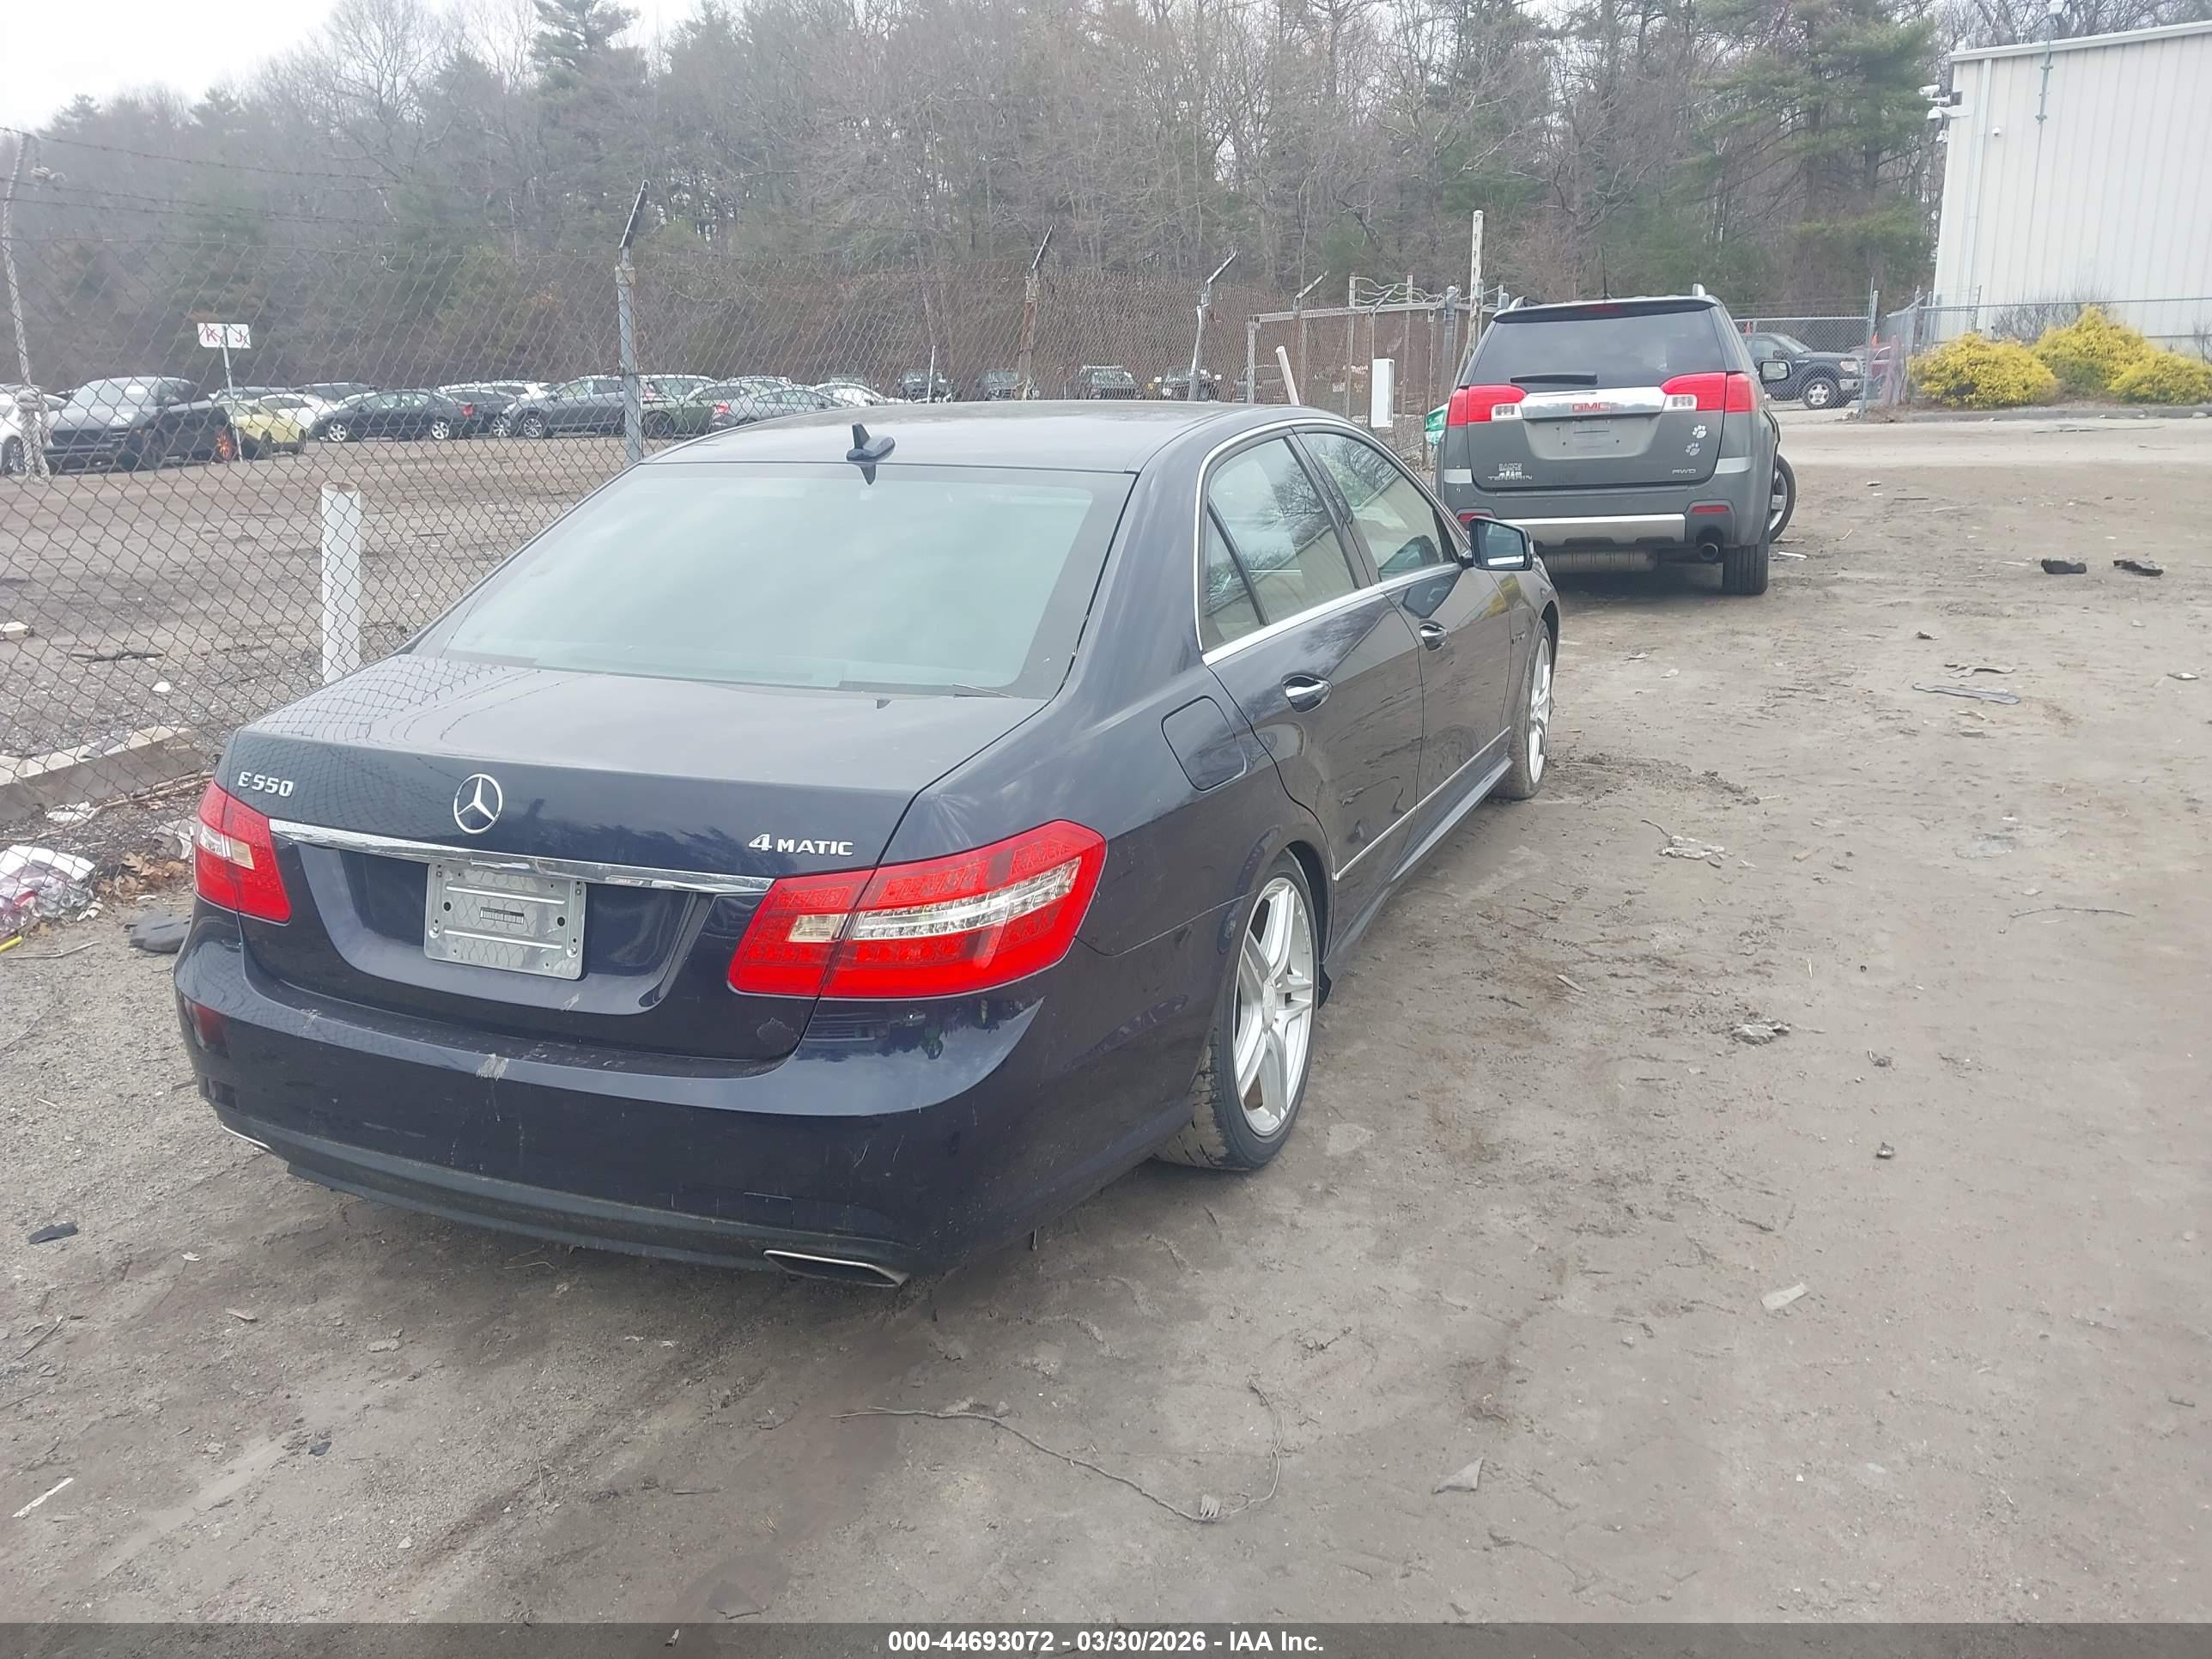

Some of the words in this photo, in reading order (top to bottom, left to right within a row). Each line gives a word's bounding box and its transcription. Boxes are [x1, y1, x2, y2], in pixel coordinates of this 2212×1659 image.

[205, 329, 218, 342] K
[235, 329, 243, 343] J
[1571, 401, 1611, 412] GMC
